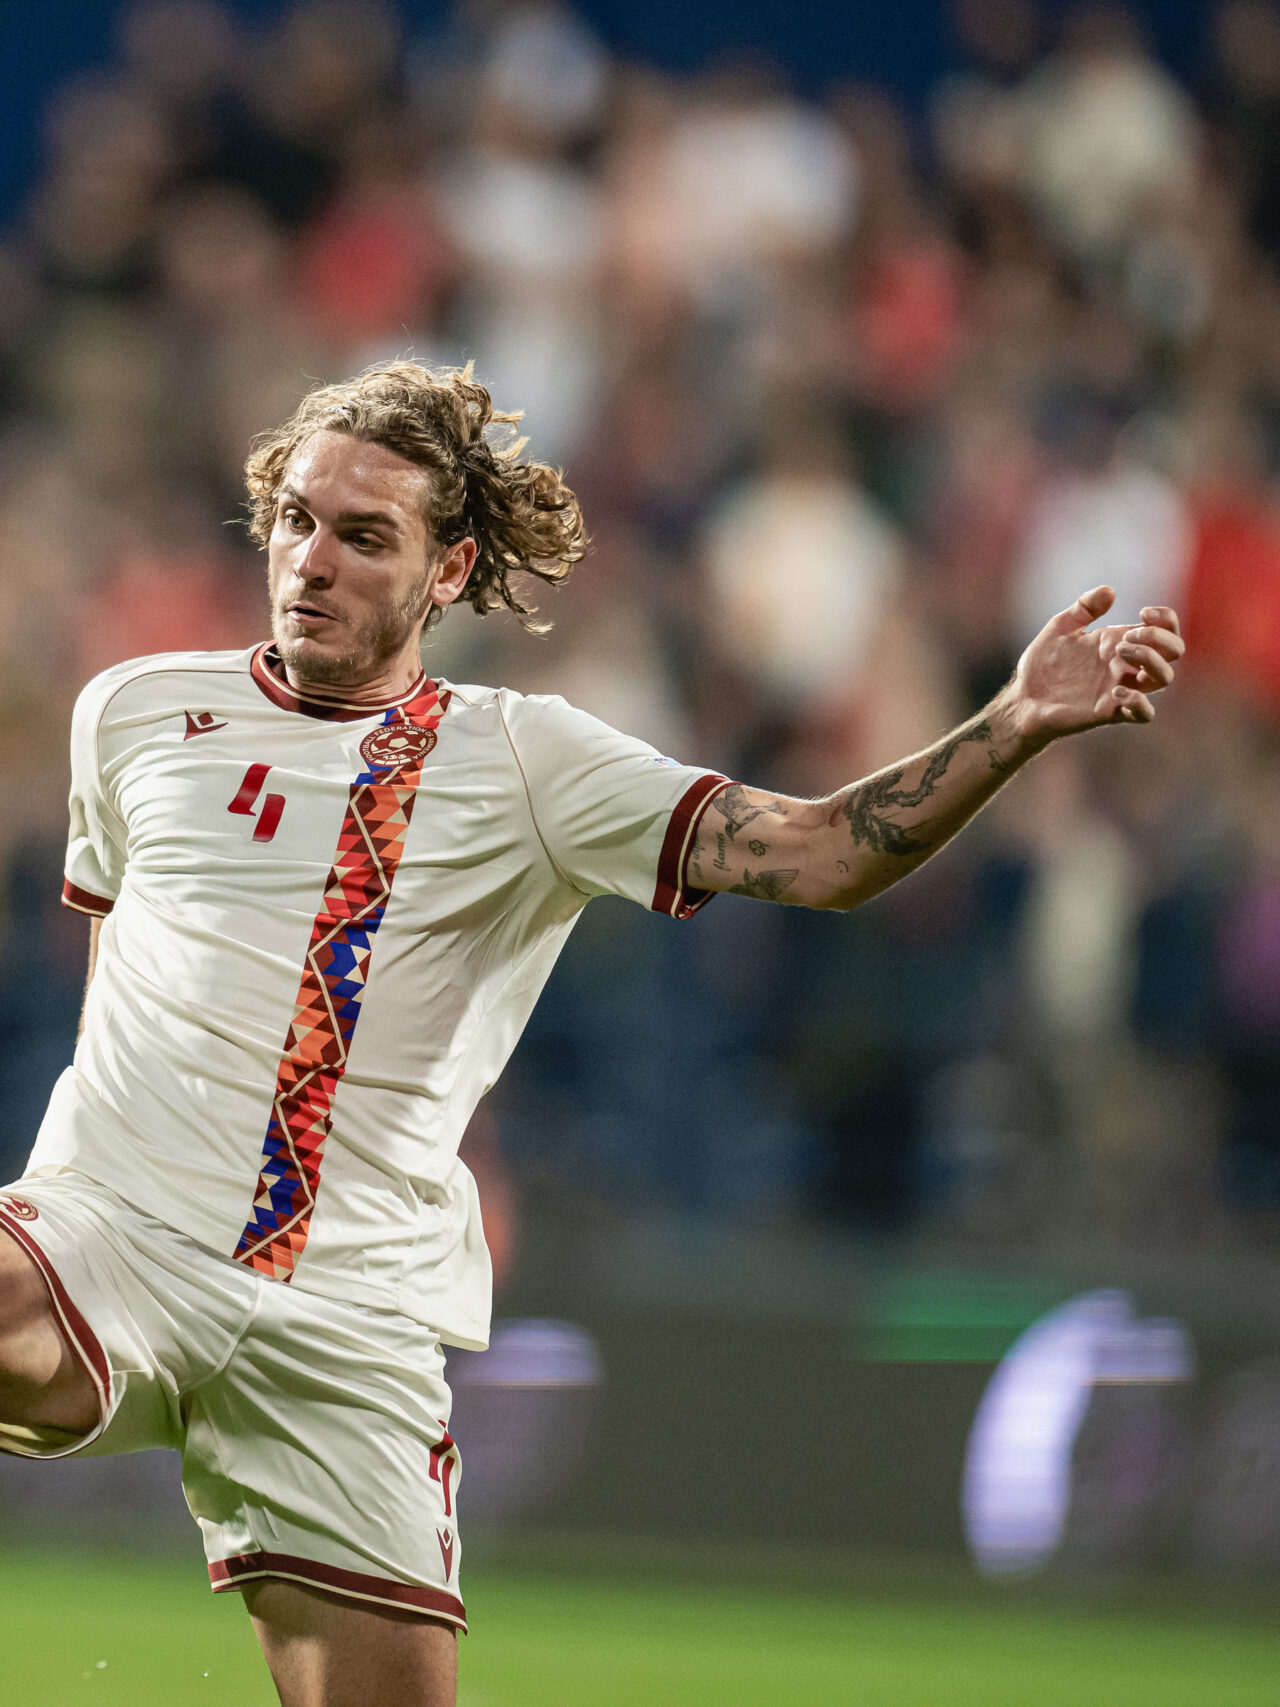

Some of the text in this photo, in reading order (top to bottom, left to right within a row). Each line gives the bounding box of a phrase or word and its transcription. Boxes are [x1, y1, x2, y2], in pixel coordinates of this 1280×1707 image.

[363, 736, 376, 761] FOOTBALL
[374, 726, 426, 736] FEDERATION
[227, 762, 287, 843] 4
